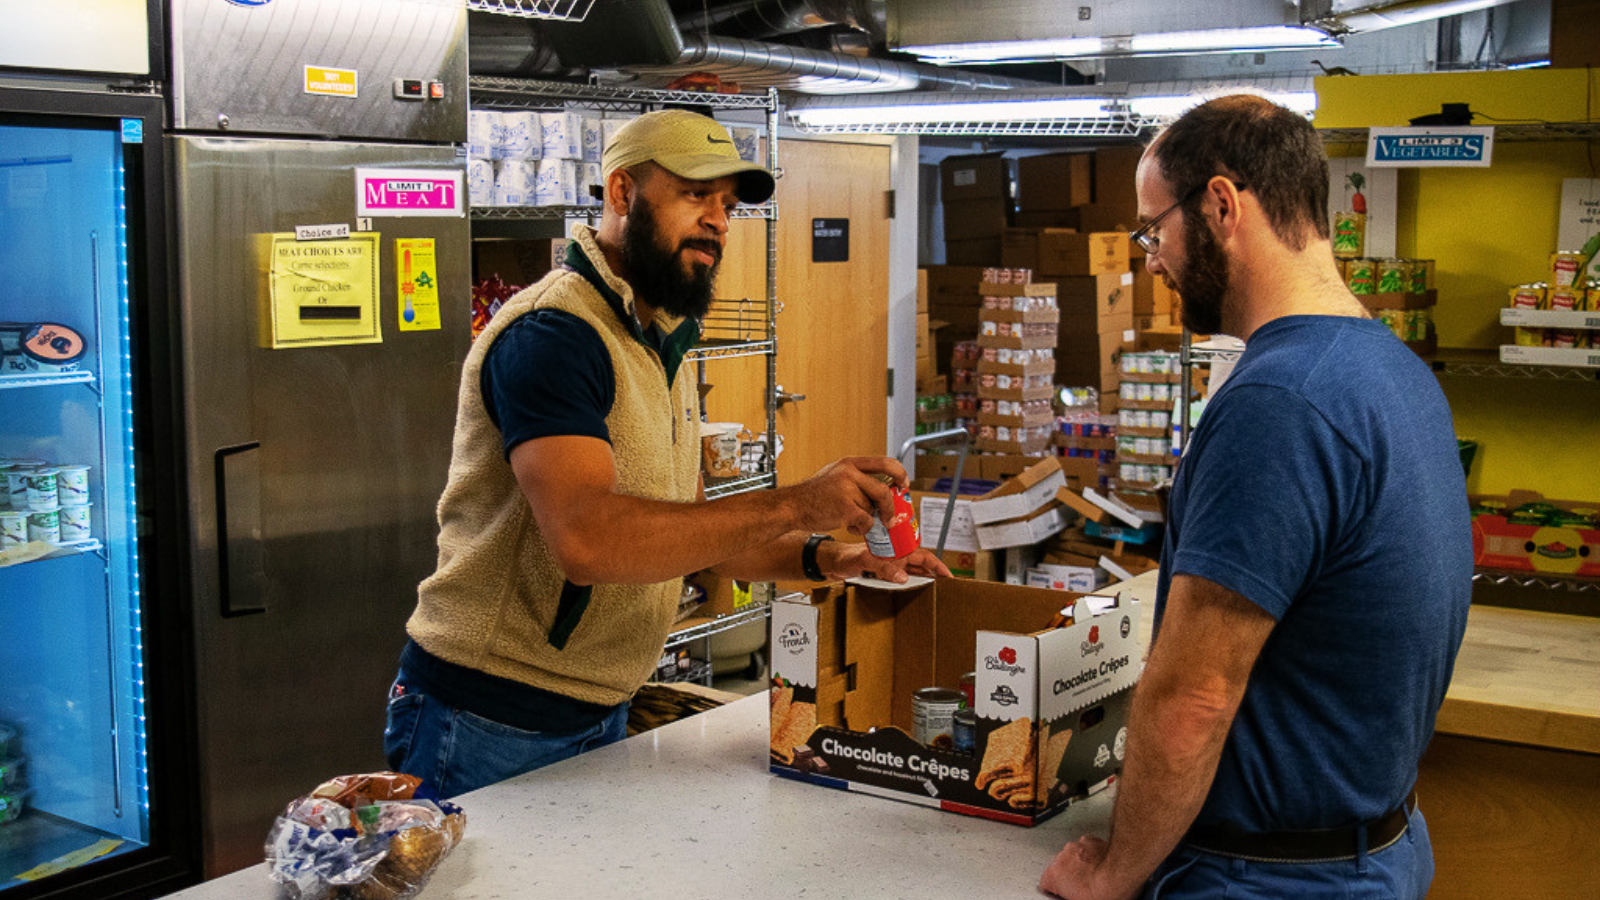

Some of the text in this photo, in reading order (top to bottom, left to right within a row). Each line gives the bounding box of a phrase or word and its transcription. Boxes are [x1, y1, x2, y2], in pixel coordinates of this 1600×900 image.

[1402, 137, 1445, 146] LIMIT
[1379, 138, 1480, 158] VEGETABLES
[388, 182, 422, 190] LIMIT
[366, 182, 454, 206] MEAT
[362, 218, 369, 231] 1
[300, 226, 347, 238] Choice of
[303, 247, 345, 256] CHOICES
[293, 283, 352, 293] Ground Chicken
[1053, 668, 1098, 696] Chocolate
[1099, 654, 1129, 676] Crêpes
[821, 738, 970, 781] Chocolate Crêpes
